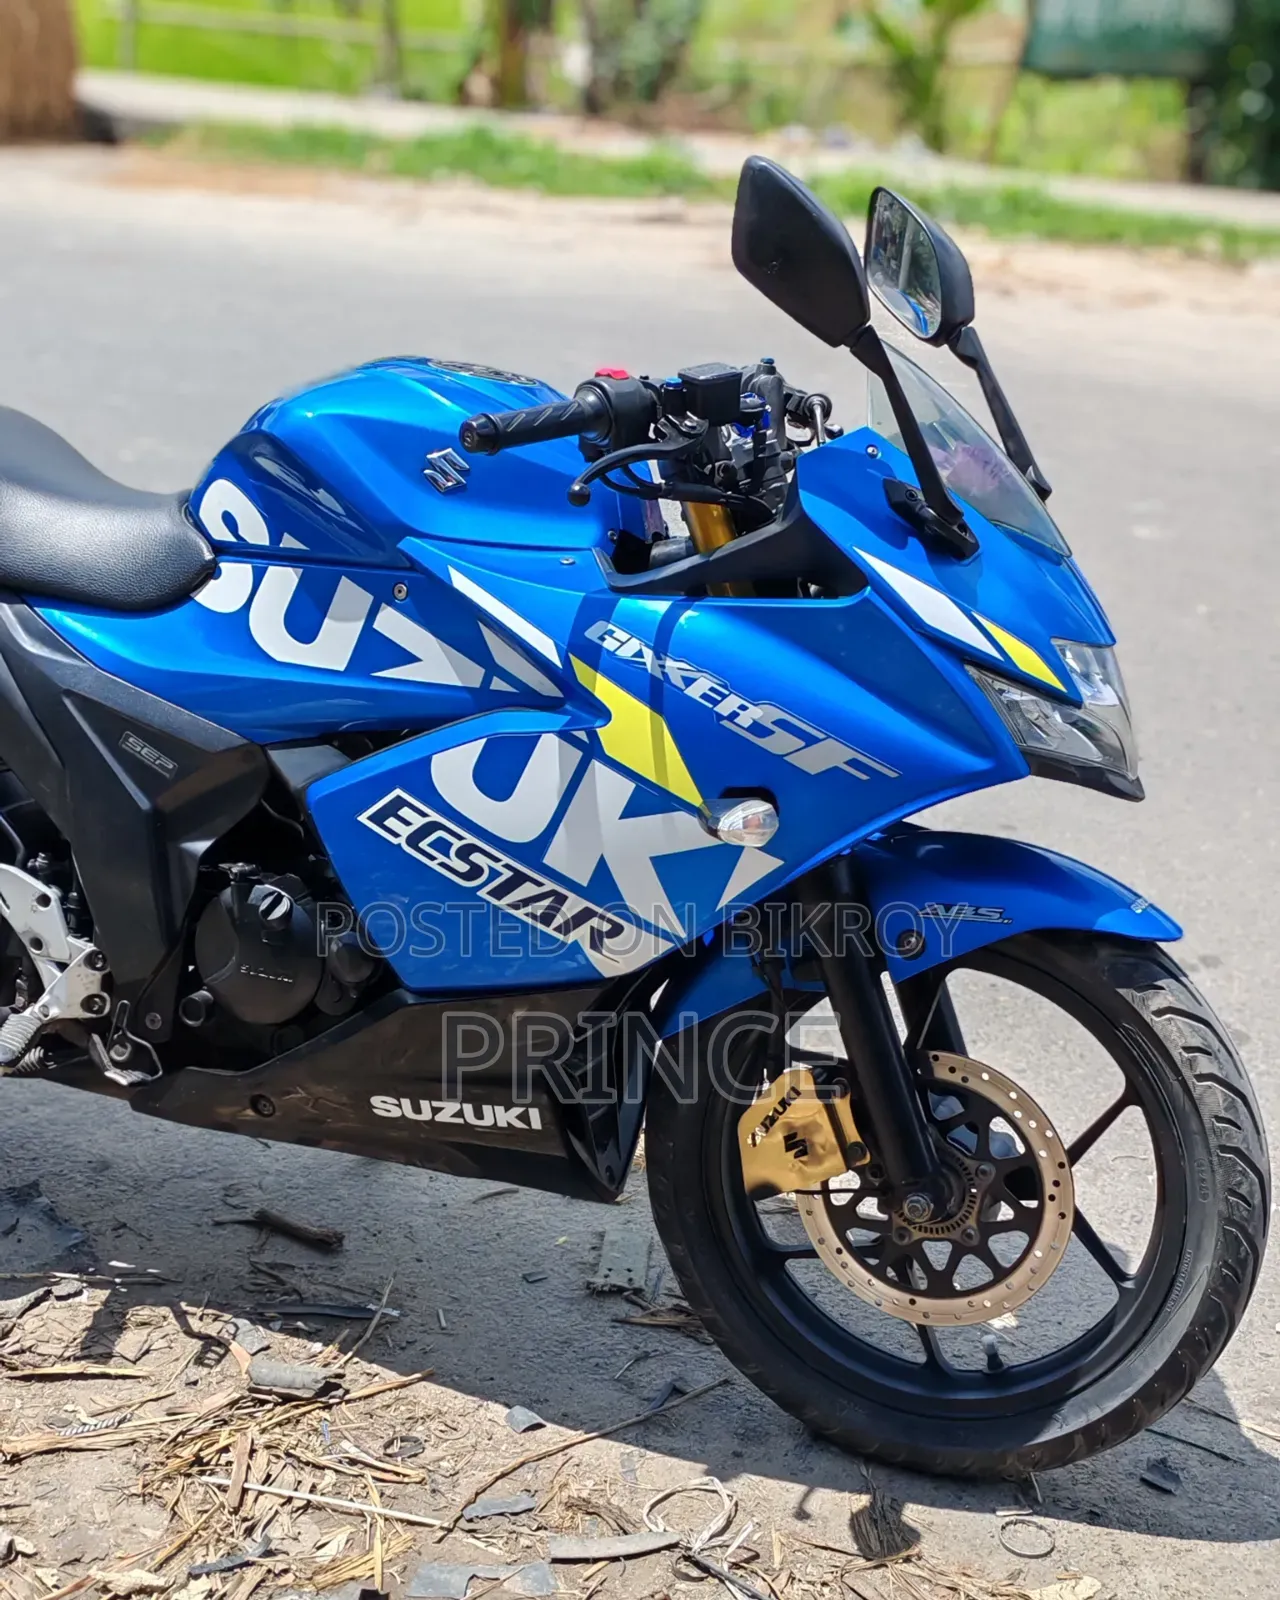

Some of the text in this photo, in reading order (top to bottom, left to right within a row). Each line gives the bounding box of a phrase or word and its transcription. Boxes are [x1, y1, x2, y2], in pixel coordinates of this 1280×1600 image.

[124, 736, 174, 769] SEP
[367, 799, 627, 963] ECSTAR
[370, 1095, 543, 1131] SUZUKI
